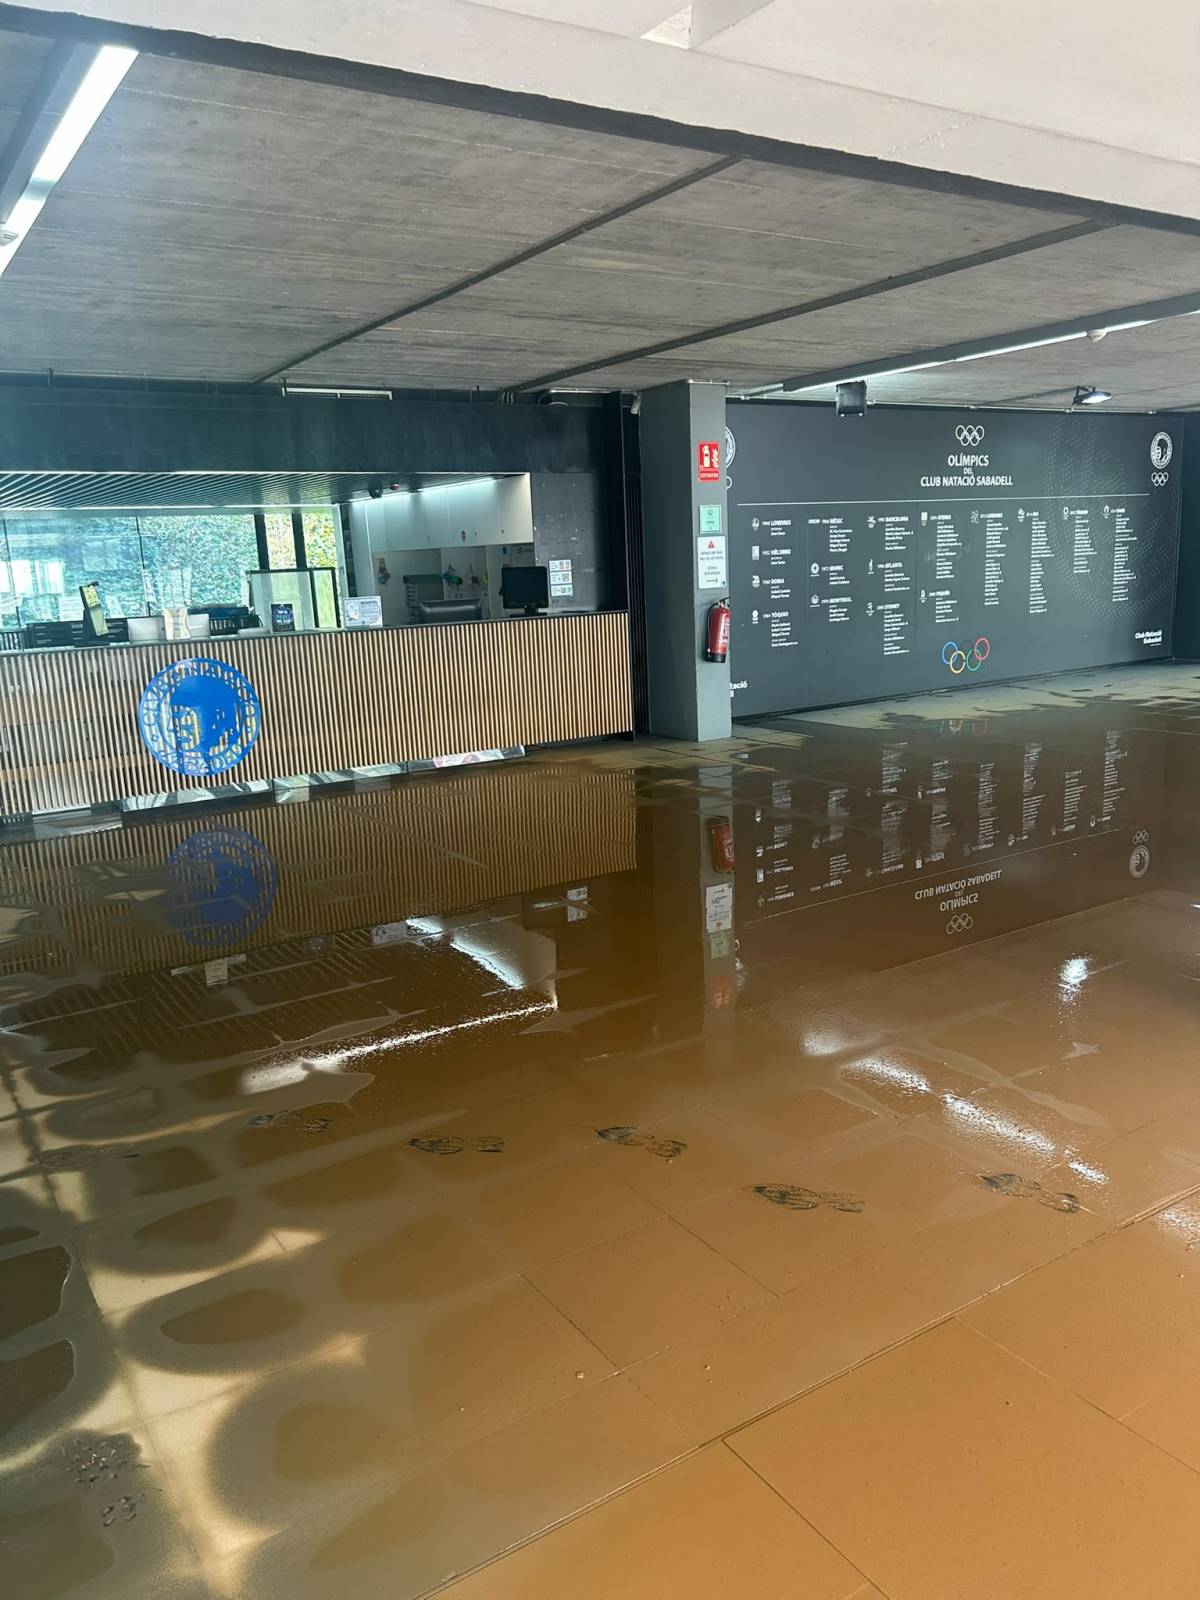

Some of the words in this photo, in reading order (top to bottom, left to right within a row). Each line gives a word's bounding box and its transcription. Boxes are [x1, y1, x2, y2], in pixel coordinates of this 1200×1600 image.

[948, 453, 989, 467] OLÍMPICS
[963, 467, 973, 475] DEL
[920, 476, 941, 487] CLUB
[942, 473, 975, 487] NATACIÓ
[976, 475, 1013, 486] SABADELL
